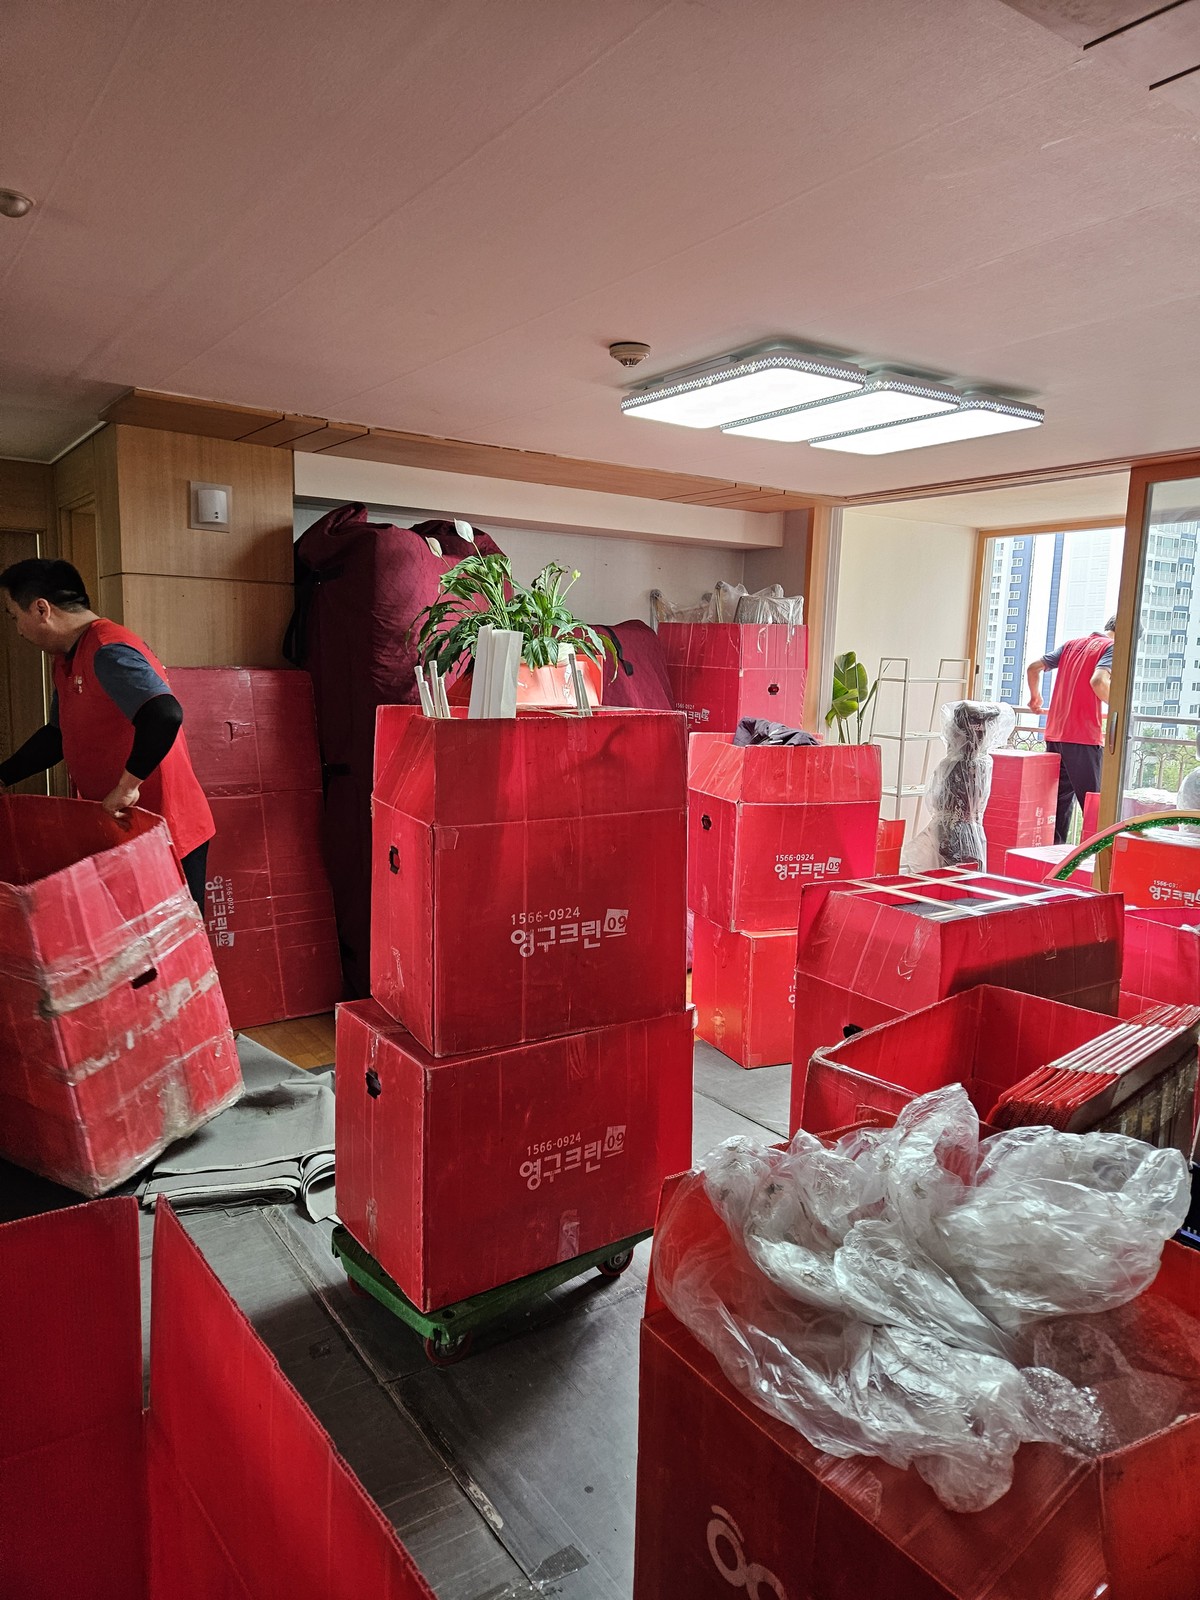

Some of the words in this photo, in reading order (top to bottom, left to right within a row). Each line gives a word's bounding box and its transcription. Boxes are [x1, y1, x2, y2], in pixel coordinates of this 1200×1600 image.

[776, 853, 815, 862] 1566-0924
[774, 862, 826, 880] 영구크린
[205, 875, 228, 932] 영구크린
[225, 878, 235, 915] 1566-0924
[1149, 885, 1195, 907] 영구크린
[510, 906, 581, 926] 1566-0924
[510, 919, 601, 958] 영구크린
[605, 913, 628, 931] 09
[526, 1131, 582, 1157] 1566-0924
[519, 1139, 602, 1191] 영구크린
[605, 1129, 625, 1150] 09
